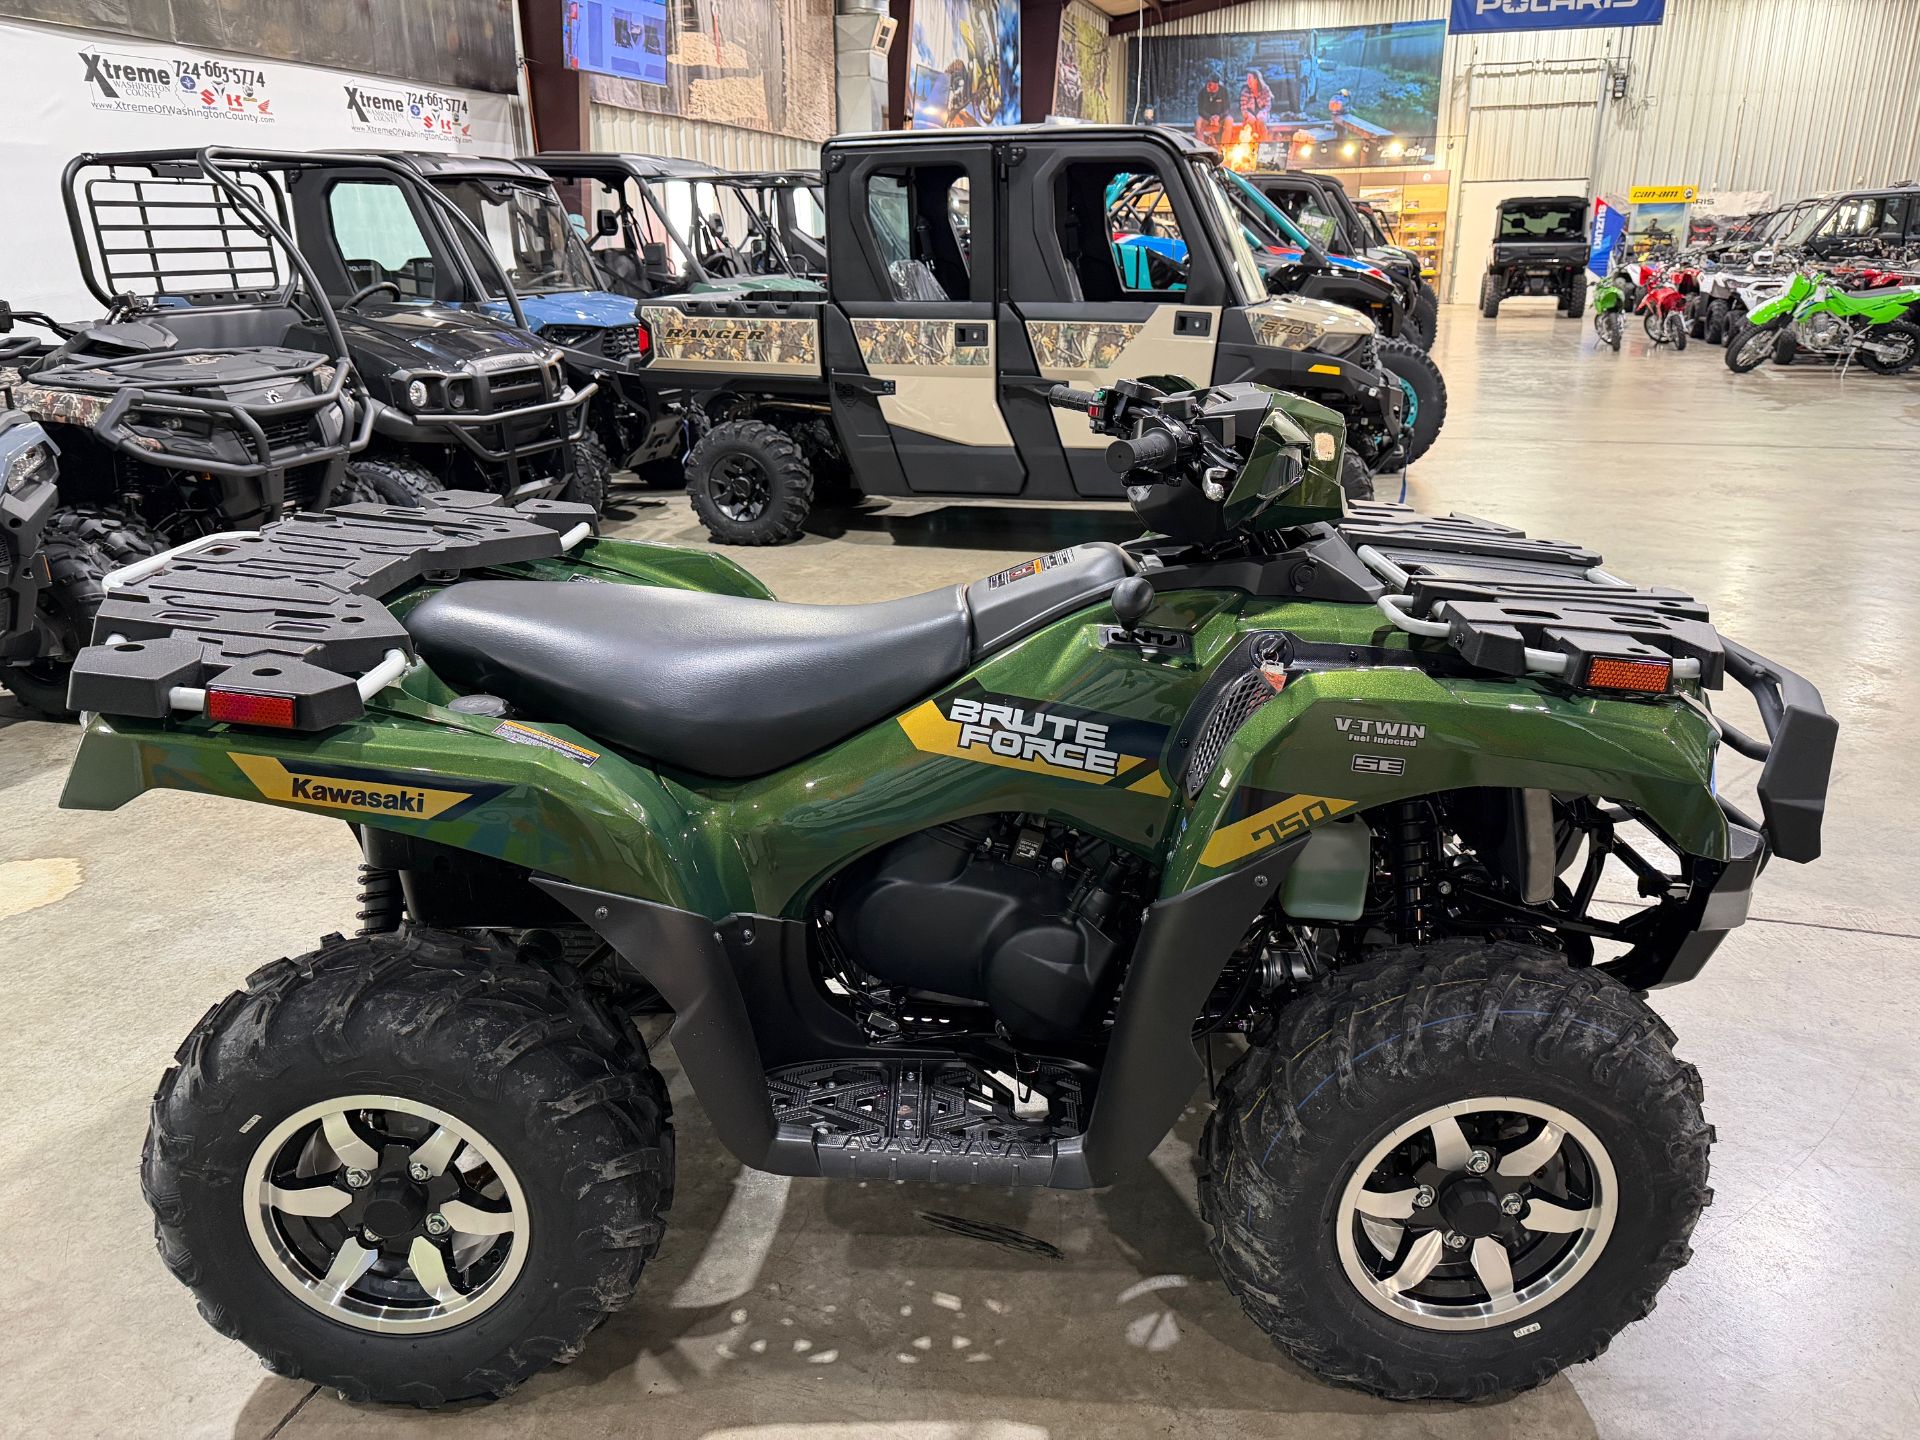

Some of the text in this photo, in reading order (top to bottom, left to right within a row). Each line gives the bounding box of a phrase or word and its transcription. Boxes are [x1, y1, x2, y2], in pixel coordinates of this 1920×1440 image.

[78, 52, 171, 98] Xtreme
[113, 80, 171, 93] WASHINGTON
[173, 60, 266, 87] 724-663-5774
[125, 88, 161, 99] COUNTY
[343, 86, 404, 123] Xtreme
[90, 101, 275, 123] www.XtremeOfWashingtonCounty.com
[1592, 204, 1607, 249] SUZUKI
[665, 328, 766, 340] RANGER
[949, 698, 1109, 749] BRUTE
[1334, 716, 1426, 739] V-TWIN
[958, 725, 1120, 775] FORCE
[1348, 733, 1417, 747] Fuel Injected
[1354, 757, 1402, 772] SE
[291, 777, 425, 813] Kawasaki
[1250, 800, 1333, 844] 750
